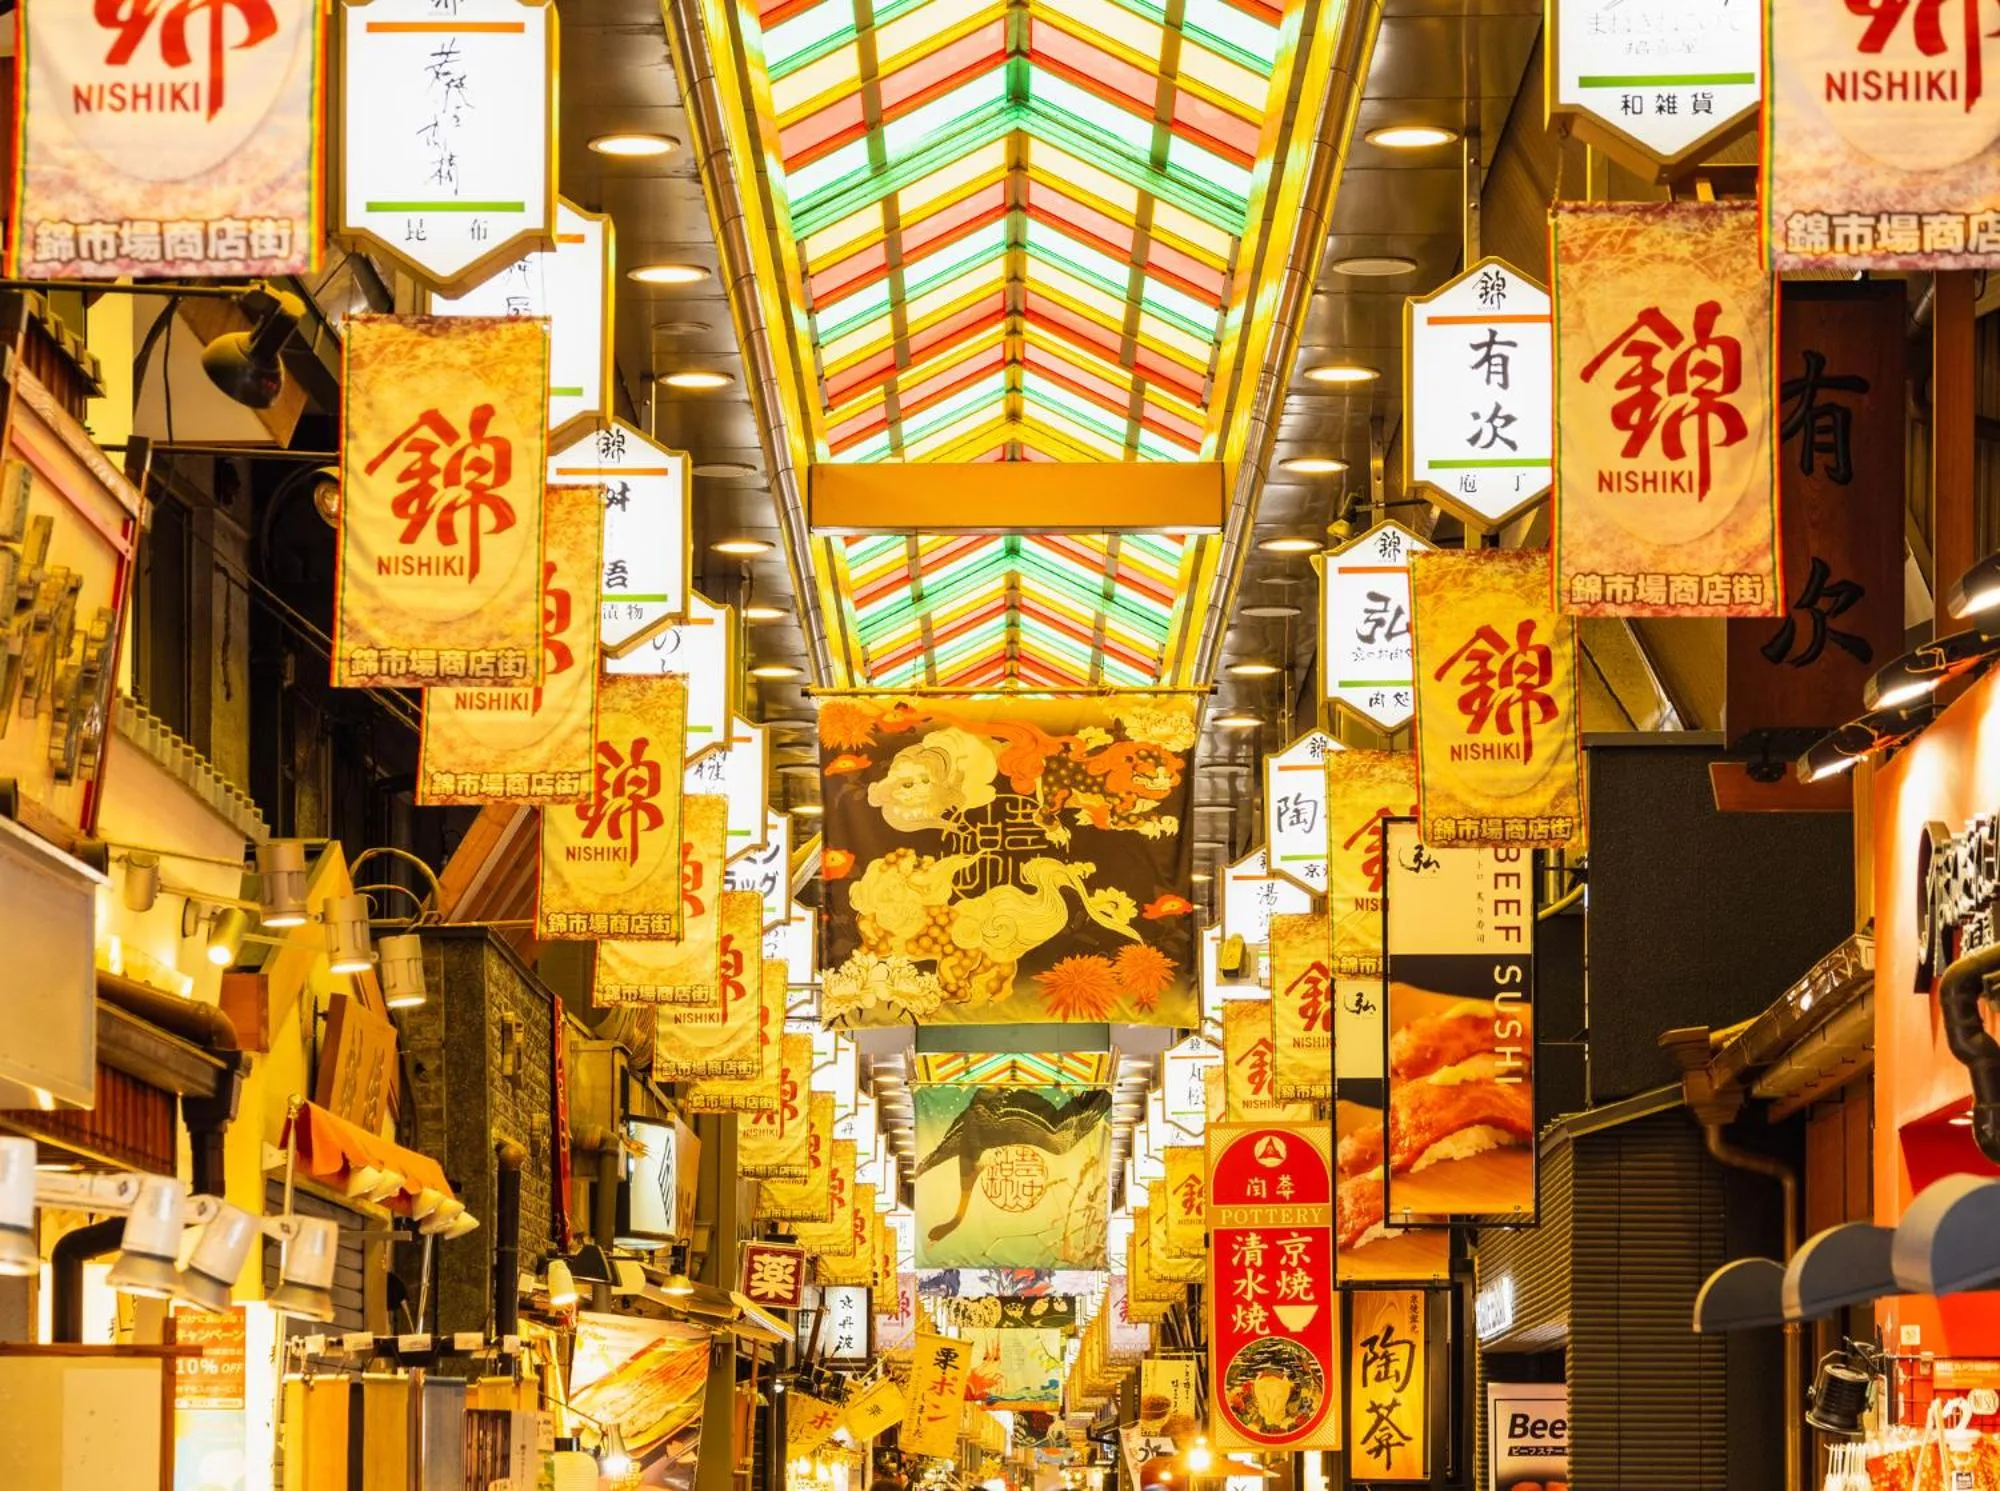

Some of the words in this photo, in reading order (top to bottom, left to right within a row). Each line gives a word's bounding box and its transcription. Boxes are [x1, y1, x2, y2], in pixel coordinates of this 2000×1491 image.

[73, 83, 200, 114] NISHIKI
[1825, 70, 1958, 102] NISHIKI
[1620, 92, 1714, 116] 和雑貨
[33, 217, 294, 263] 錦市場商店街
[1785, 210, 2000, 256] 錦市場商店
[1472, 271, 1507, 311] 錦
[1466, 328, 1519, 452] 有次
[1580, 300, 1748, 502] 錦
[364, 404, 516, 584] 錦
[1598, 470, 1694, 494] NISHIKI
[1761, 349, 1874, 668] 有次
[377, 556, 464, 577] NISHIKI
[1571, 573, 1764, 607] 錦市場商店街
[350, 647, 527, 681] 錦市場商店街
[455, 692, 529, 712] NISHIKI
[1434, 619, 1559, 766] 錦
[1450, 743, 1521, 763] NISHIKI
[431, 771, 582, 797] 錦市場商店街
[1430, 815, 1573, 841] 錦市場商店街
[566, 846, 628, 863] NISHIKI
[1493, 847, 1521, 943] BEEF
[547, 912, 673, 934] 錦市場商店街
[604, 984, 711, 1002] 錦市場商店街
[674, 1012, 720, 1025] NISHIKI
[1493, 965, 1522, 1084] SUSHI
[1220, 1207, 1323, 1225] POTTERY
[751, 1254, 797, 1299] 薬
